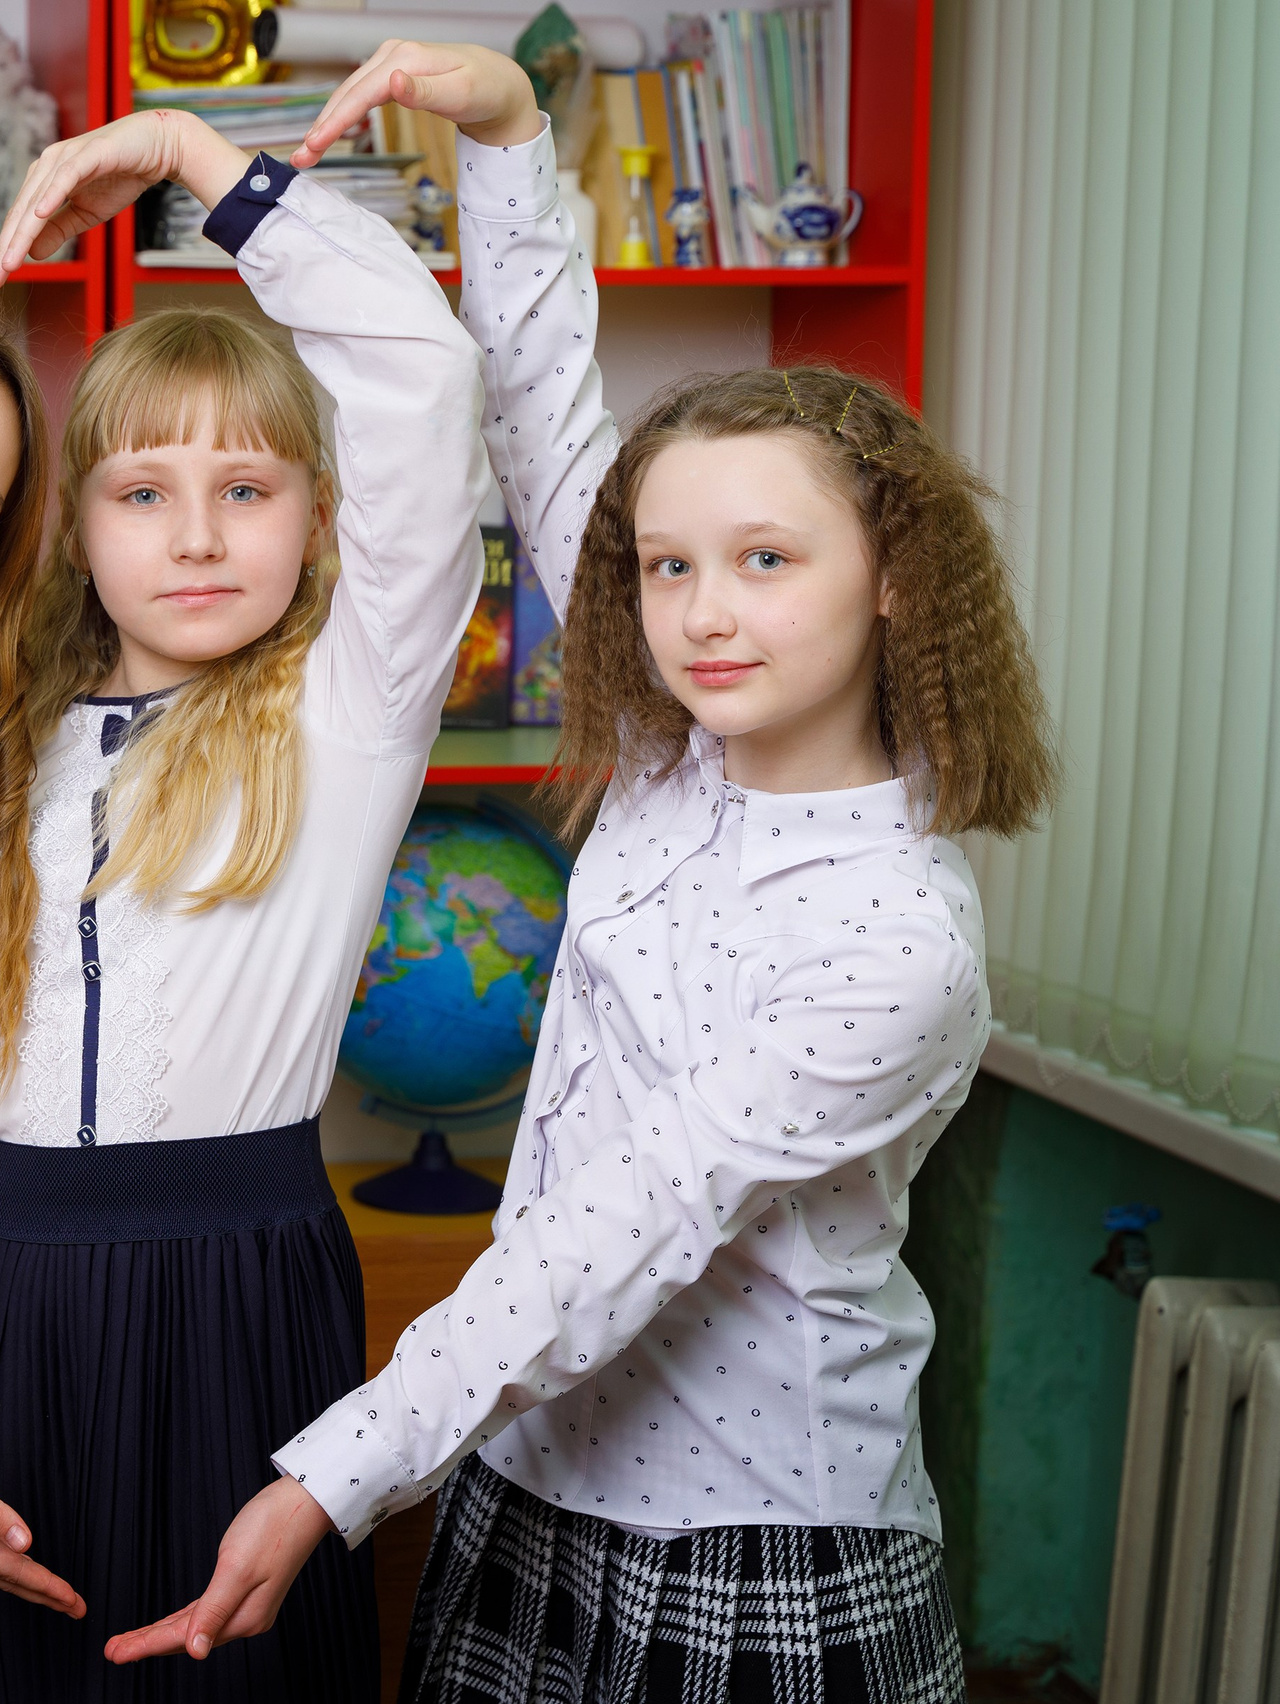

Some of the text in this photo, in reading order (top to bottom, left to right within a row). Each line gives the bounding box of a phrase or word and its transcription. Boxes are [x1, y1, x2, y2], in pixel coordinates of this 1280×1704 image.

[533, 268, 544, 278] B
[578, 488, 588, 498] B
[806, 809, 815, 819] B
[893, 822, 906, 830] B
[871, 898, 880, 909] B
[627, 905, 636, 914] B
[712, 909, 720, 919] B
[709, 942, 720, 950] B
[637, 948, 648, 957] B
[703, 983, 713, 993] B
[652, 993, 663, 1001] B
[886, 1004, 900, 1014] B
[805, 1046, 816, 1057] B
[555, 1108, 563, 1118] B
[744, 1106, 753, 1118] B
[704, 1170, 714, 1180] B
[582, 1262, 593, 1274] B
[742, 1285, 753, 1294] B
[785, 1313, 795, 1323] B
[820, 1334, 831, 1344] B
[898, 1363, 908, 1371] B
[466, 1387, 476, 1399] B
[895, 1438, 902, 1449] B
[540, 1446, 551, 1454] B
[634, 1456, 646, 1466] B
[791, 1468, 803, 1477] B
[297, 1473, 307, 1483] B
